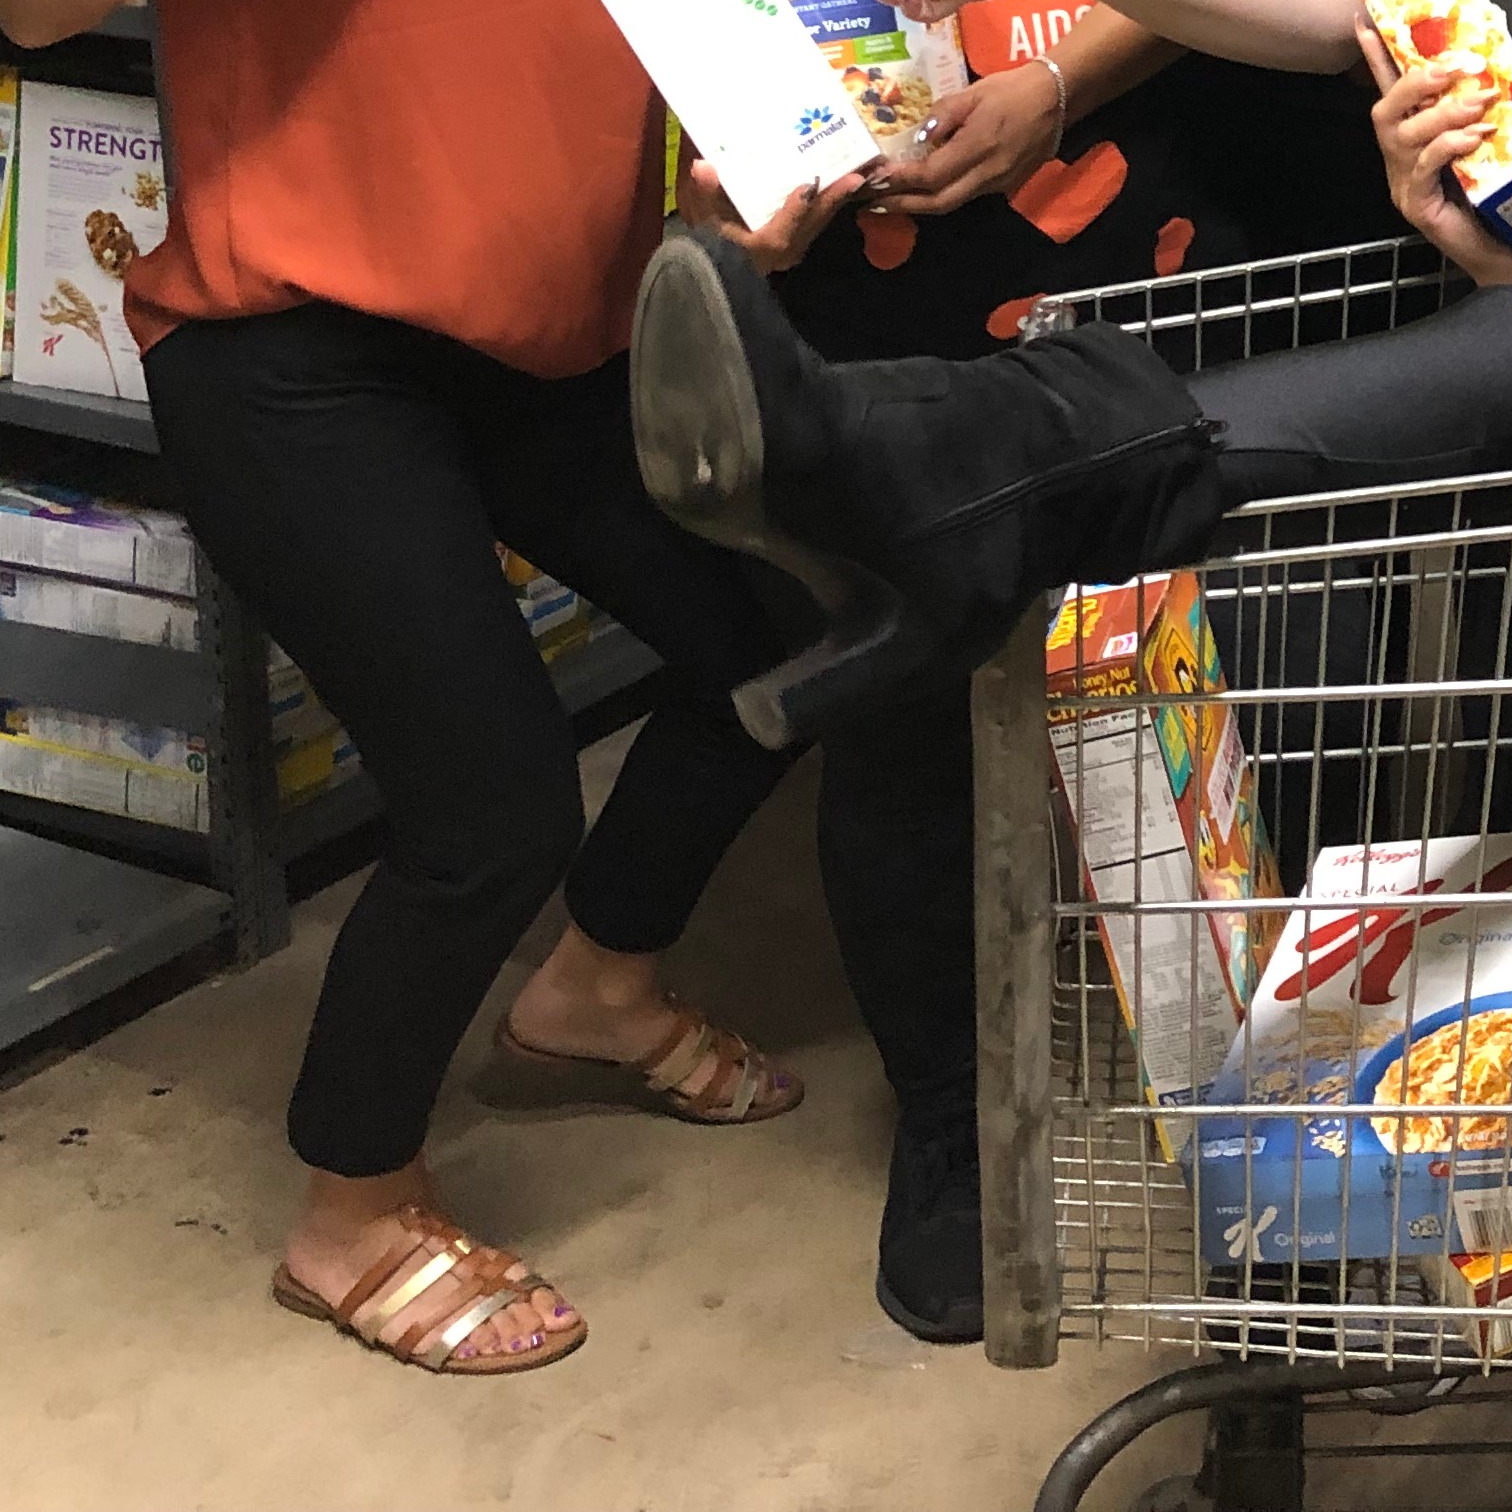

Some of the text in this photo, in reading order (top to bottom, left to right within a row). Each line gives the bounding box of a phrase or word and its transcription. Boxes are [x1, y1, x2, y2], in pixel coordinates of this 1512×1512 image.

[822, 16, 872, 34] Variety
[1009, 4, 1093, 62] AID
[50, 125, 163, 163] STRENGT
[796, 117, 848, 155] parmalat
[1109, 666, 1130, 681] Nut
